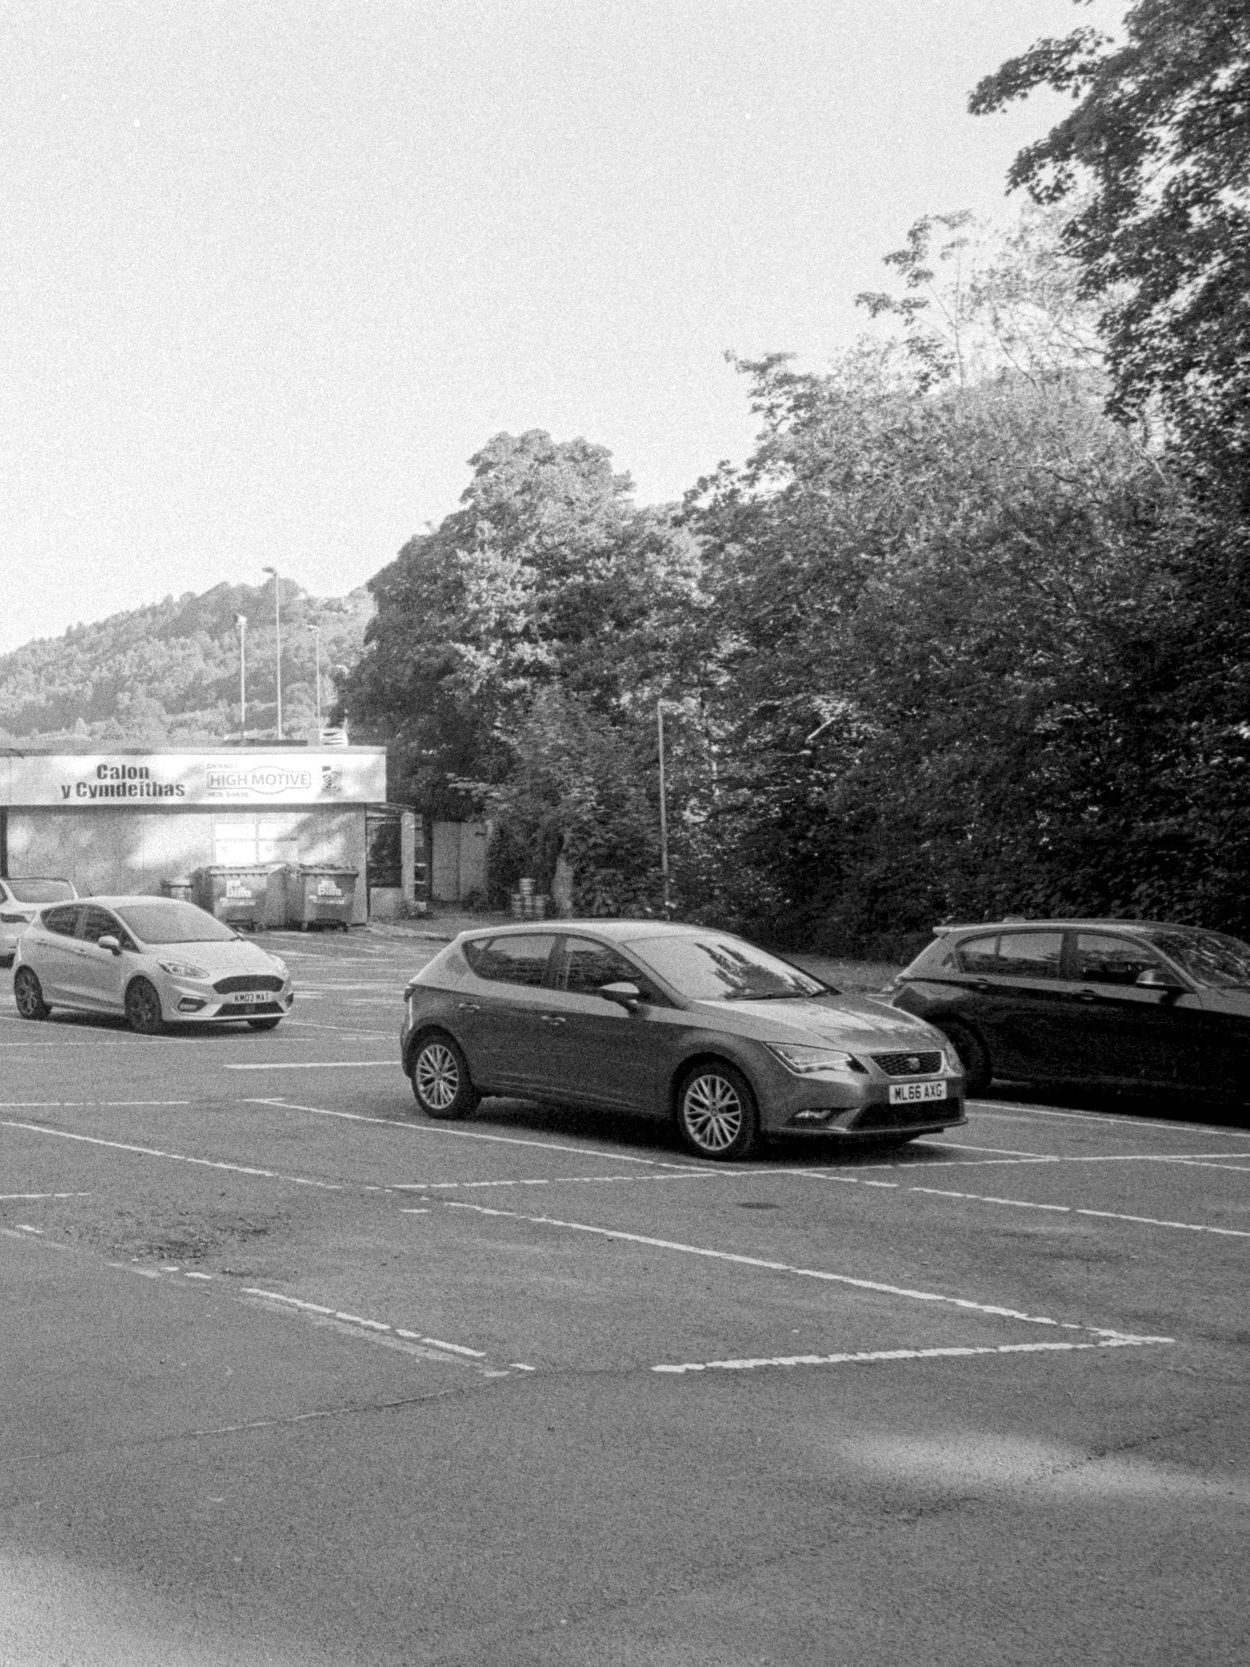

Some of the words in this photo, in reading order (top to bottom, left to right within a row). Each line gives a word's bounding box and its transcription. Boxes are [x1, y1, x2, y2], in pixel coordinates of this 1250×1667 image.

[96, 764, 150, 780] Calon
[209, 773, 248, 787] HIGH
[251, 773, 309, 786] MOTIVE
[61, 784, 71, 799] y
[76, 781, 186, 799] Cymdeithas
[894, 1084, 922, 1101] ML66
[924, 1083, 942, 1098] AXG
